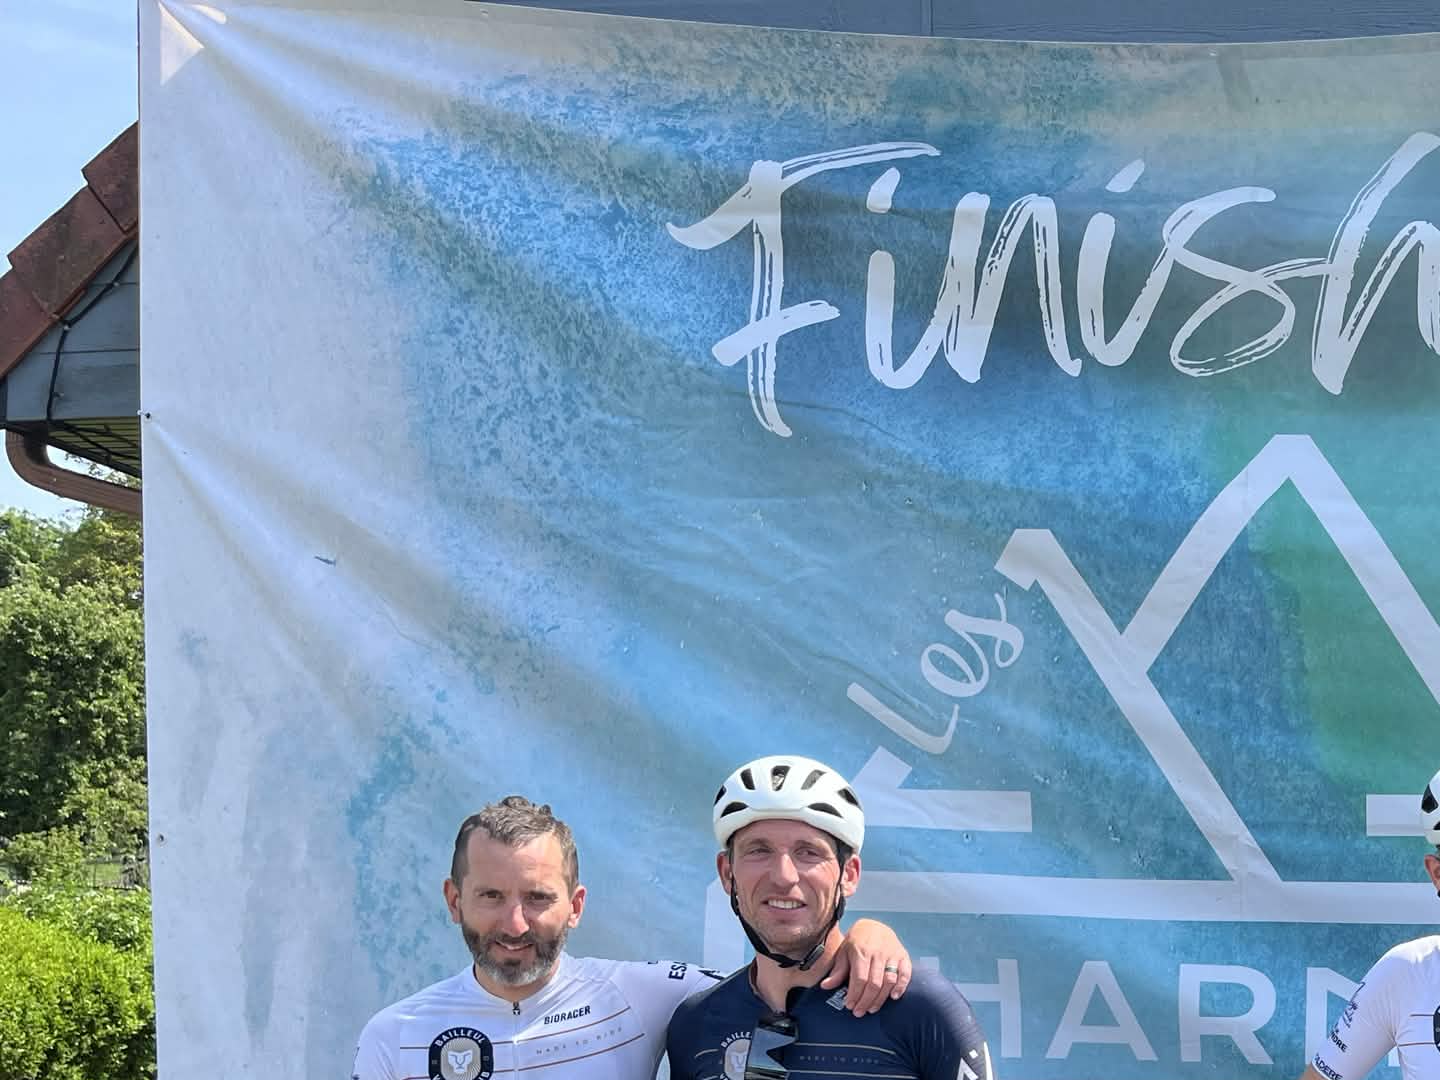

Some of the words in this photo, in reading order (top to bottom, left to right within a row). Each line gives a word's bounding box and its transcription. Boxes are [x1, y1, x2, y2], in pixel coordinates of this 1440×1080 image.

[845, 587, 1028, 756] Les
[544, 1005, 591, 1025] BIORACER
[435, 1027, 486, 1048] BAILLEUL
